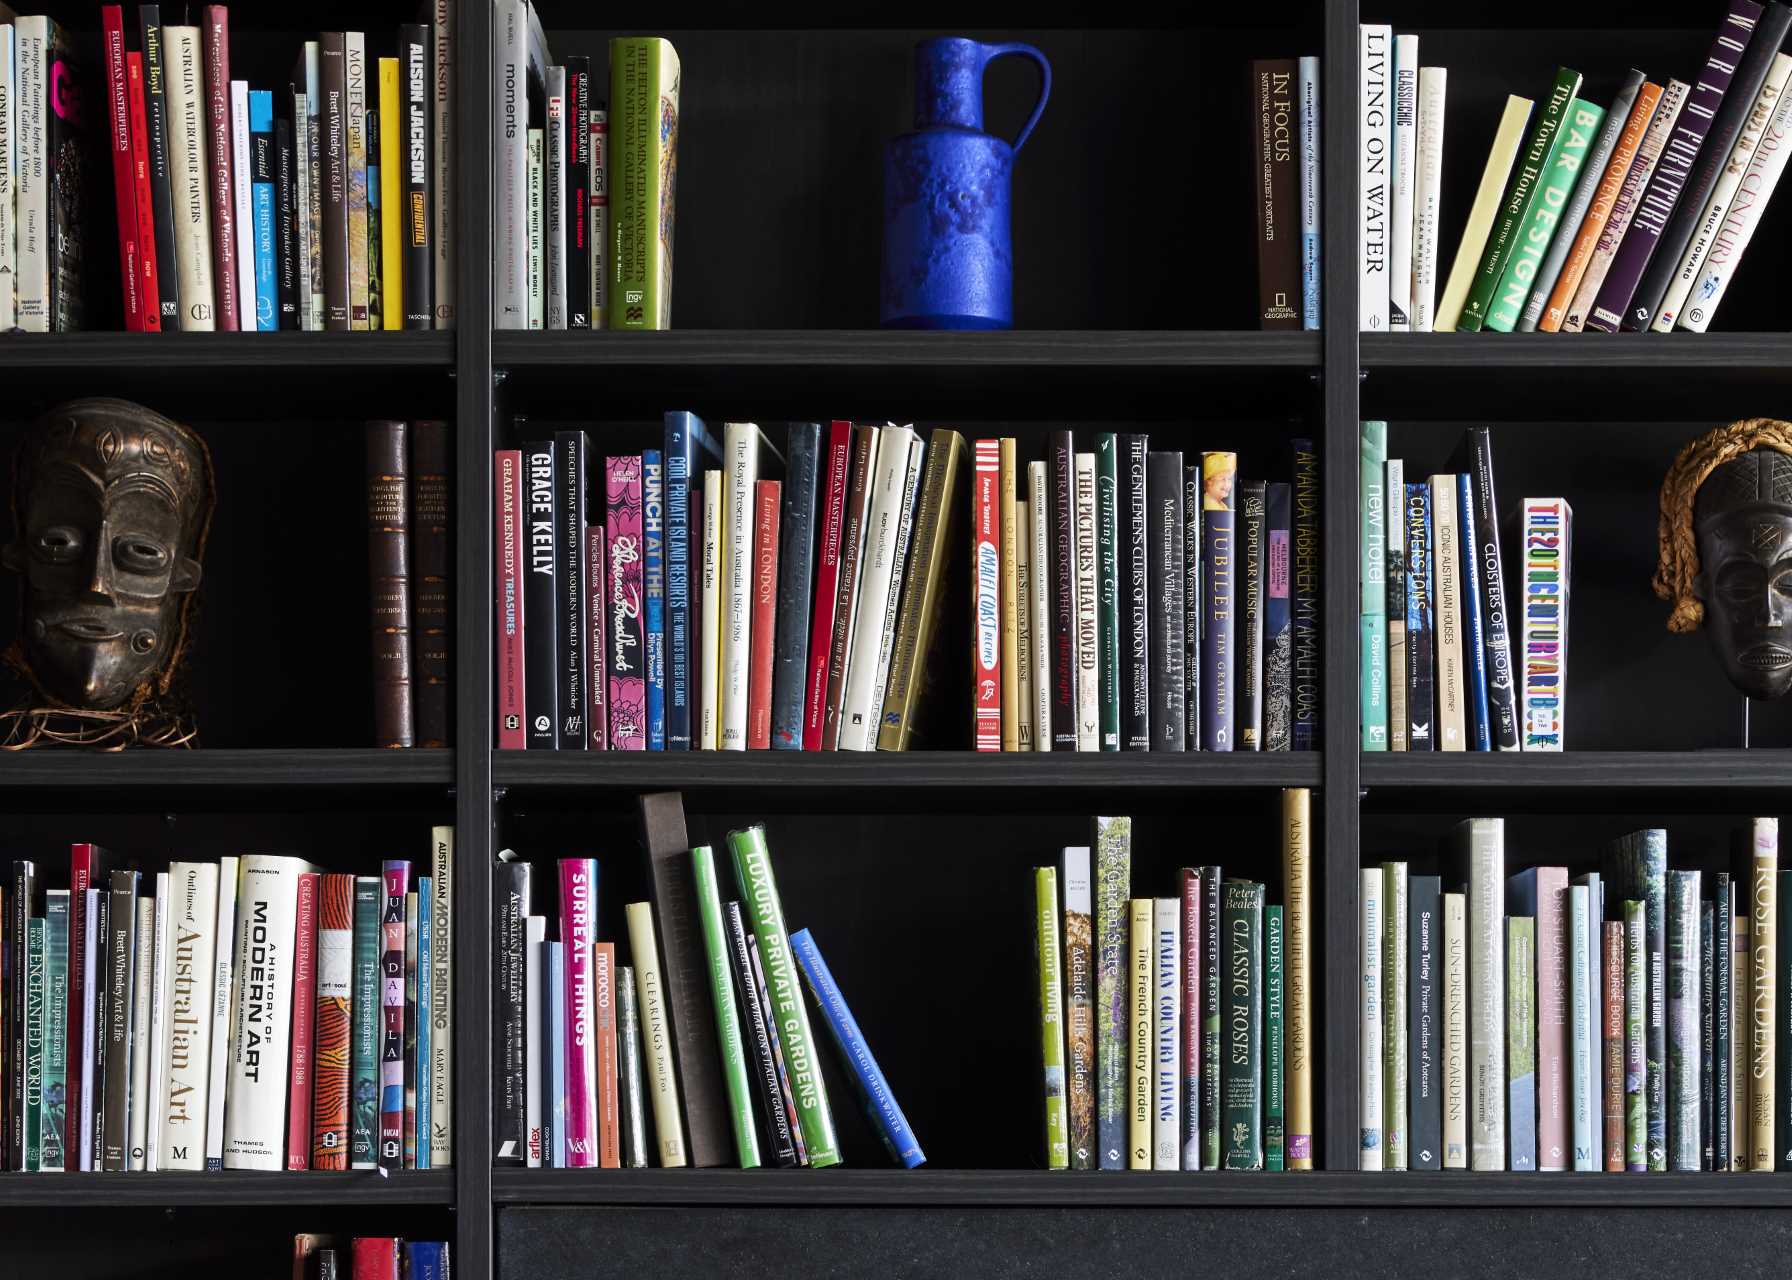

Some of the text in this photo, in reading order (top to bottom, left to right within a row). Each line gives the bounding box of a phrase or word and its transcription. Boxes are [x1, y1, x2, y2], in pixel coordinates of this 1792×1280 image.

[31, 38, 42, 178] European Paintings before 1800
[111, 29, 128, 152] EUROPEAN MASTERPIECES
[409, 43, 425, 184] ALISON JACKSON
[505, 64, 518, 138] moments
[578, 72, 588, 164] CREATIVE PHOTOGRAPHY
[1687, 13, 1756, 120] WORLD
[181, 36, 201, 224] AUSTRALIAN WATERCOLOUR PAINTERS
[595, 138, 604, 192] Canon EOS
[635, 45, 649, 282] THE FELTON ILLUMINATED MANUSCRIPTS
[1261, 73, 1274, 241] NATIONAL GEOGRAPHIC GREATEST PORTRAITS
[1366, 33, 1384, 275] LIVING ON WATER
[1634, 126, 1703, 236] FURNITURE
[259, 185, 271, 253] ART HISTORY
[1503, 109, 1598, 309] BAR DESIGN
[503, 457, 515, 636] GRAHAM KENNEDY TREASURES
[531, 452, 554, 575] GRACE KELLY
[646, 463, 663, 598] PUNCH AT THE
[668, 456, 688, 608] COOL PRIVATE ISLAND RESORTS
[759, 496, 775, 604] Living in LONDON
[827, 443, 845, 565] EUROPEAN MASTERPIECES
[1037, 495, 1045, 516] MOORE
[1057, 447, 1070, 623] AUSTRALIAN GEOGRAPHIC
[1163, 499, 1176, 613] Mediterranean Villages
[1185, 481, 1196, 644] CLASSIC WALKS IN WESTERN EUROPE
[1368, 484, 1386, 584] new hotel
[1410, 496, 1425, 611] CONVERSIONS
[704, 541, 714, 589] Moral Tales
[886, 578, 901, 632] Women Artists
[1018, 562, 1029, 682] THE STREETS OF MELBOURNE
[1079, 468, 1095, 670] THE PICTURES THAT MOVED
[1213, 527, 1230, 622] JUBILEE
[1484, 543, 1508, 683] CLOISTERS OF EUROPE
[593, 593, 603, 705] Venice Carnival Unmasked
[1218, 632, 1226, 715] TIM GRAHAM
[1371, 634, 1382, 706] David Collins
[296, 879, 312, 983] CREATING AUSTRALIA
[572, 873, 588, 1048] SURREAL THINGS
[746, 853, 817, 1110] LUXURY PRIVATE GARDENS
[1042, 909, 1059, 1023] outdoor living
[1364, 899, 1381, 1021] minimalist garden
[1420, 911, 1431, 980] Suzanne Turley
[28, 953, 42, 1106] ENCHANTED WORLD
[53, 974, 65, 1067] The Impressionists
[245, 901, 268, 1083] MODERN ART
[265, 943, 276, 1043] A HISTORY OF
[645, 972, 669, 1093] CLEARINGS Paul Fox
[1135, 948, 1148, 1122] The French Country Garden
[1232, 918, 1250, 1065] CLASSIC ROSES
[1421, 985, 1431, 1098] Private Gardens of Aotearoa
[1448, 938, 1462, 1121] SUN-DRENCHED GARDENS
[436, 1048, 445, 1105] MARY EAGLE
[531, 1127, 541, 1159] arflex
